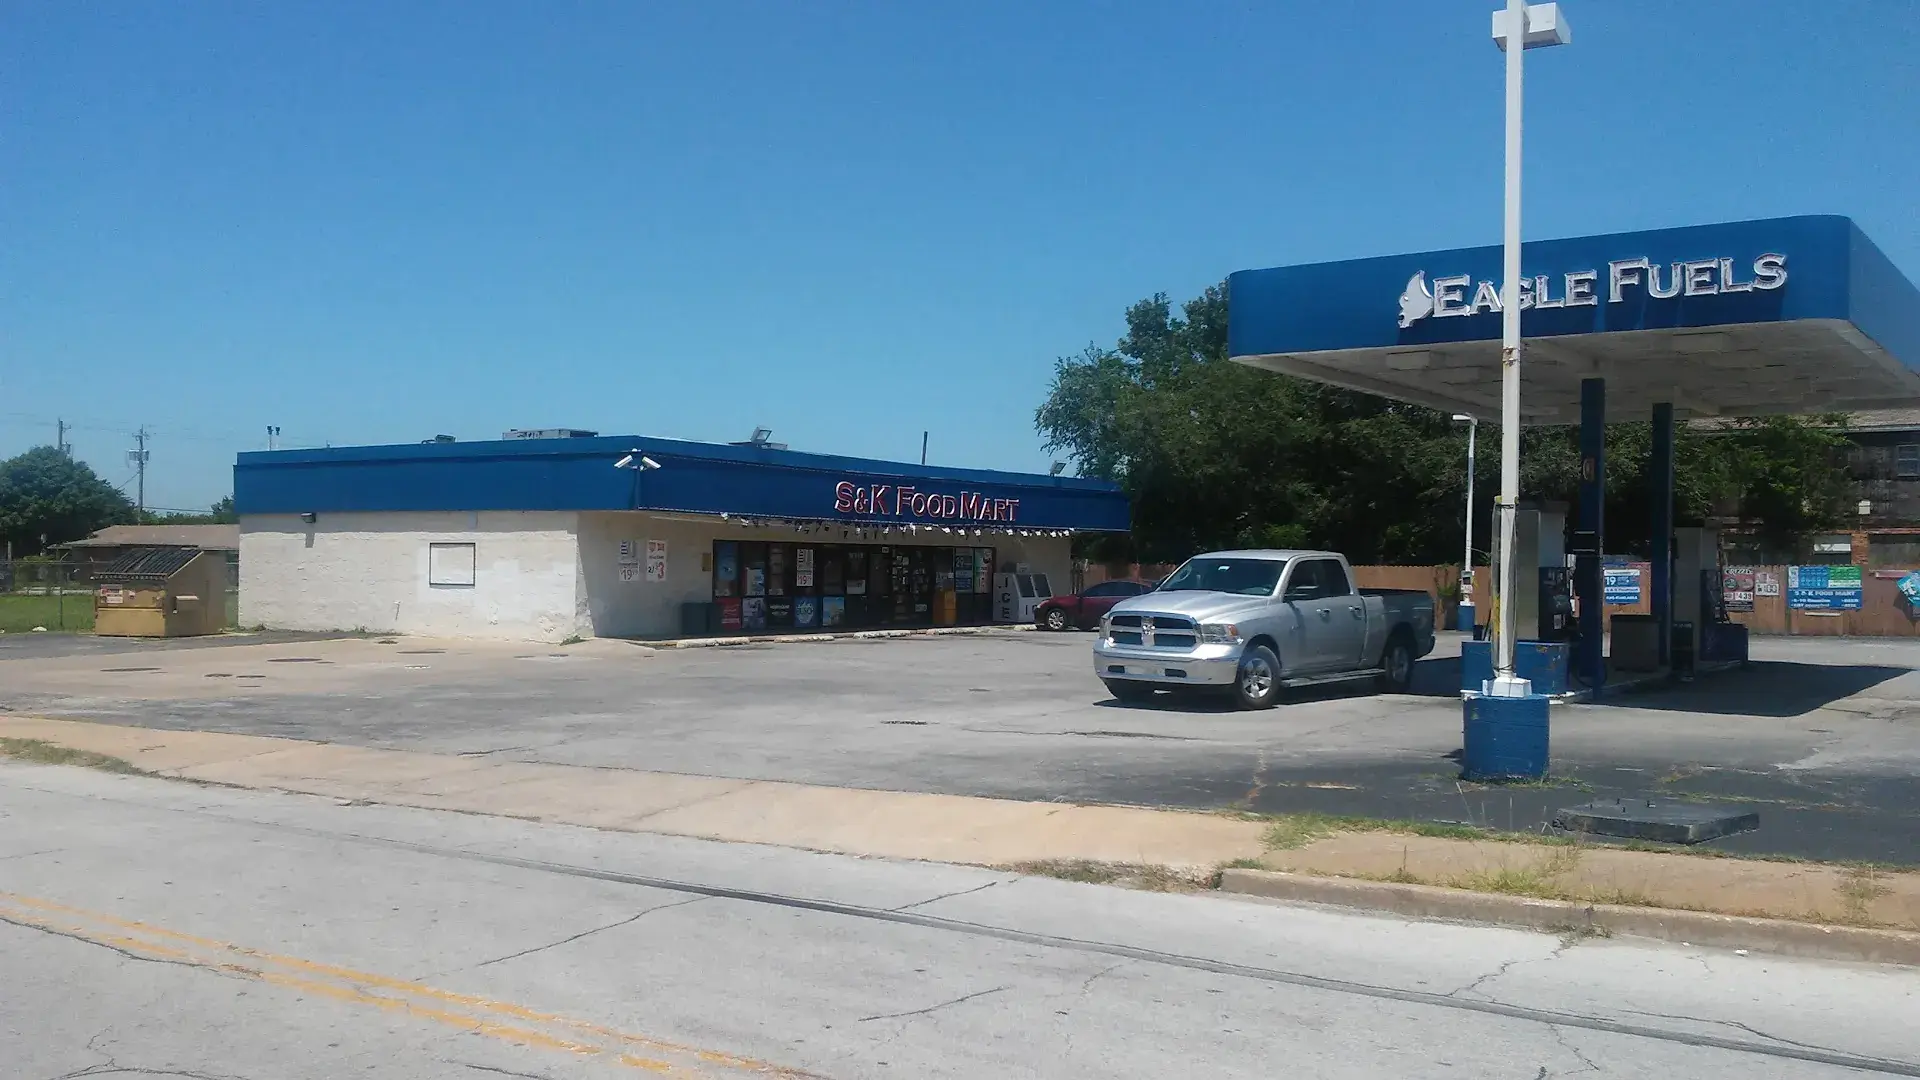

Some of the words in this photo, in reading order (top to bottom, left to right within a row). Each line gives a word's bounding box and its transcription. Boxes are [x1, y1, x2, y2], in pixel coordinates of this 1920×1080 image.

[1432, 269, 1597, 318] EAGLE
[1608, 252, 1787, 302] FUELS
[835, 481, 891, 515] S&K
[895, 486, 956, 518] FOOD
[959, 491, 1020, 522] MART
